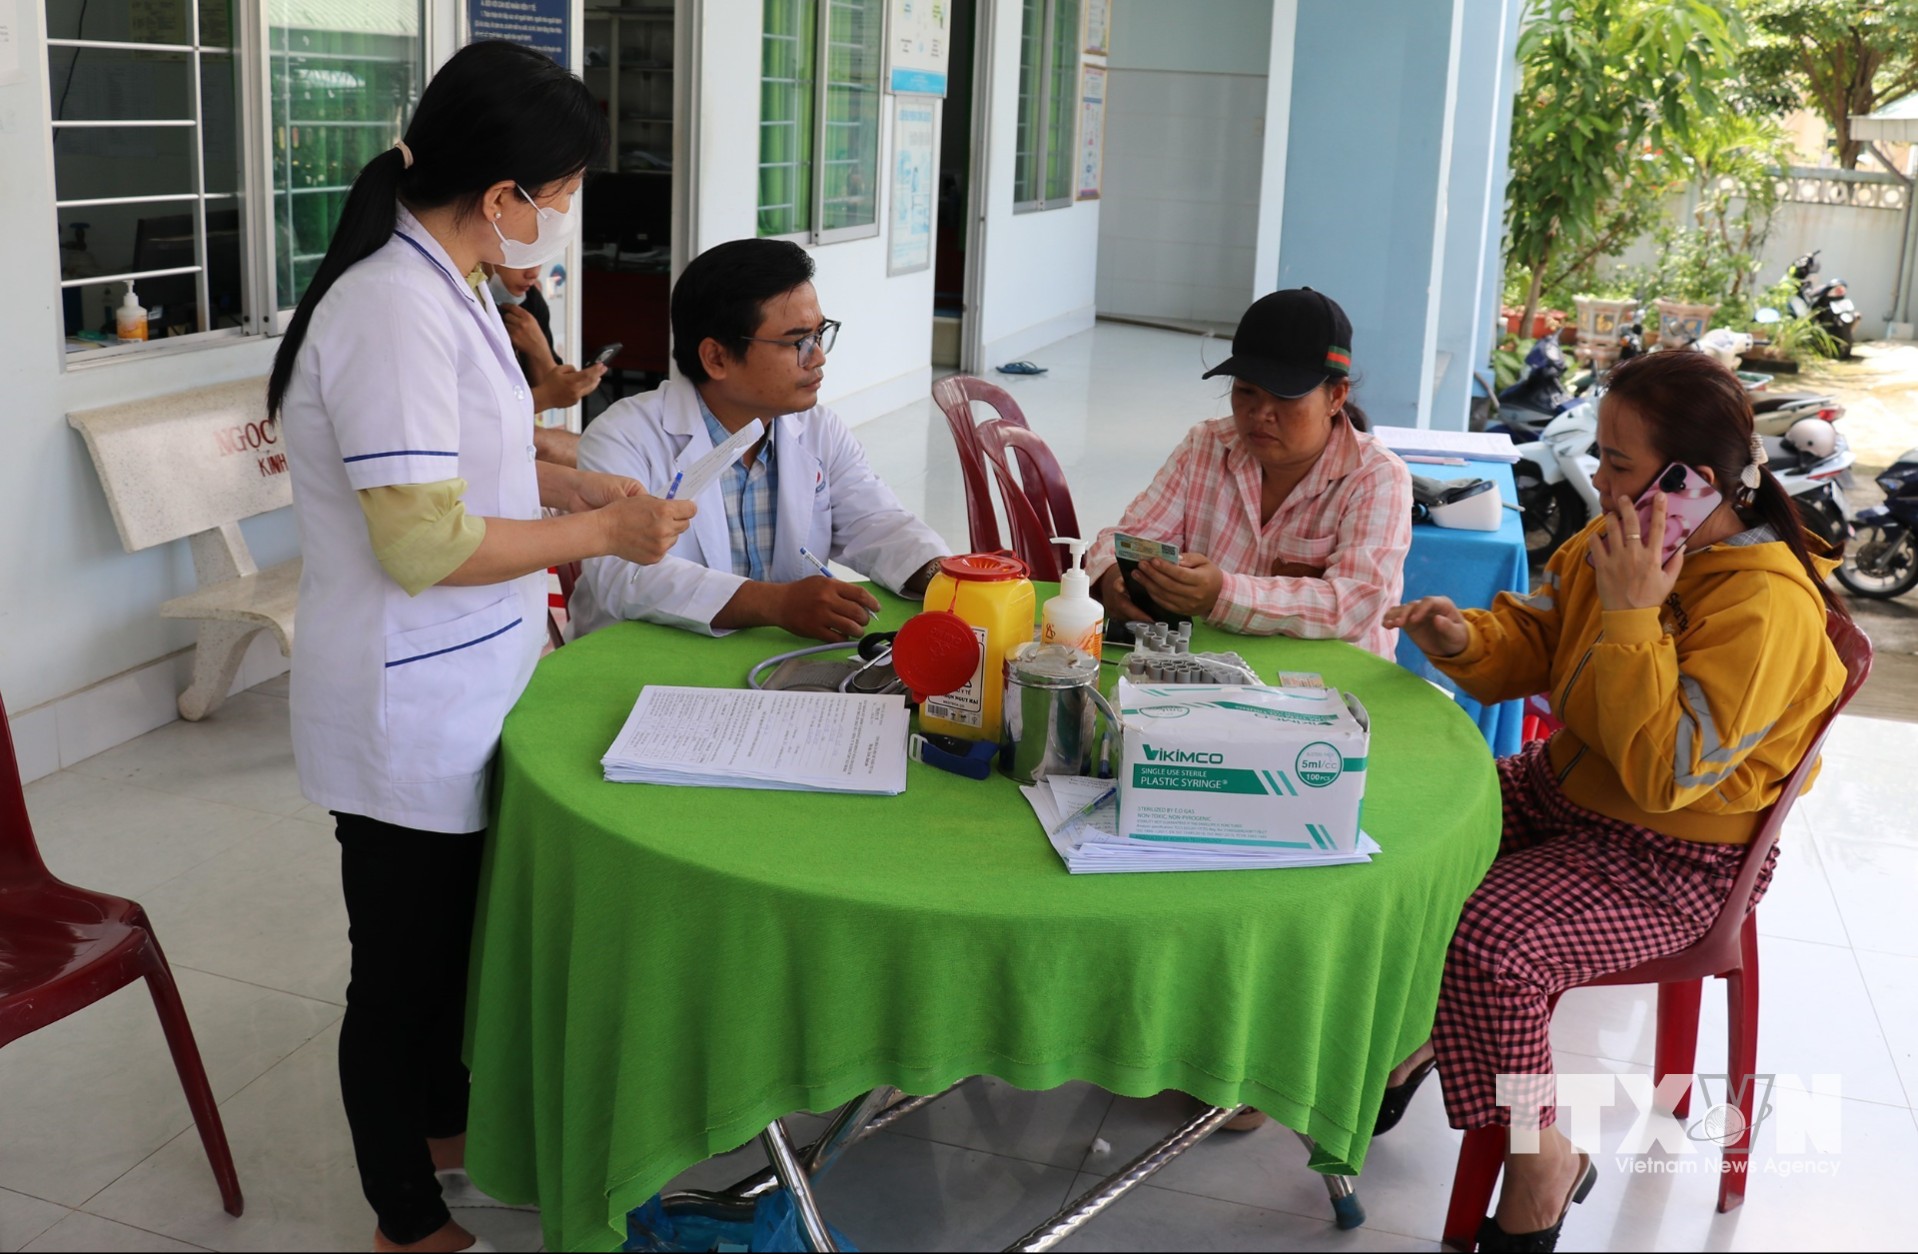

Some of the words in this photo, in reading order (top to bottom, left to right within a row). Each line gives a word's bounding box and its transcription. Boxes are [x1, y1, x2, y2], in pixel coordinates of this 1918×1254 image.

[1141, 767, 1165, 775] SINGLE
[1166, 768, 1180, 776] USE
[1181, 769, 1207, 777] STERILE
[1141, 776, 1179, 787] PLASTIC
